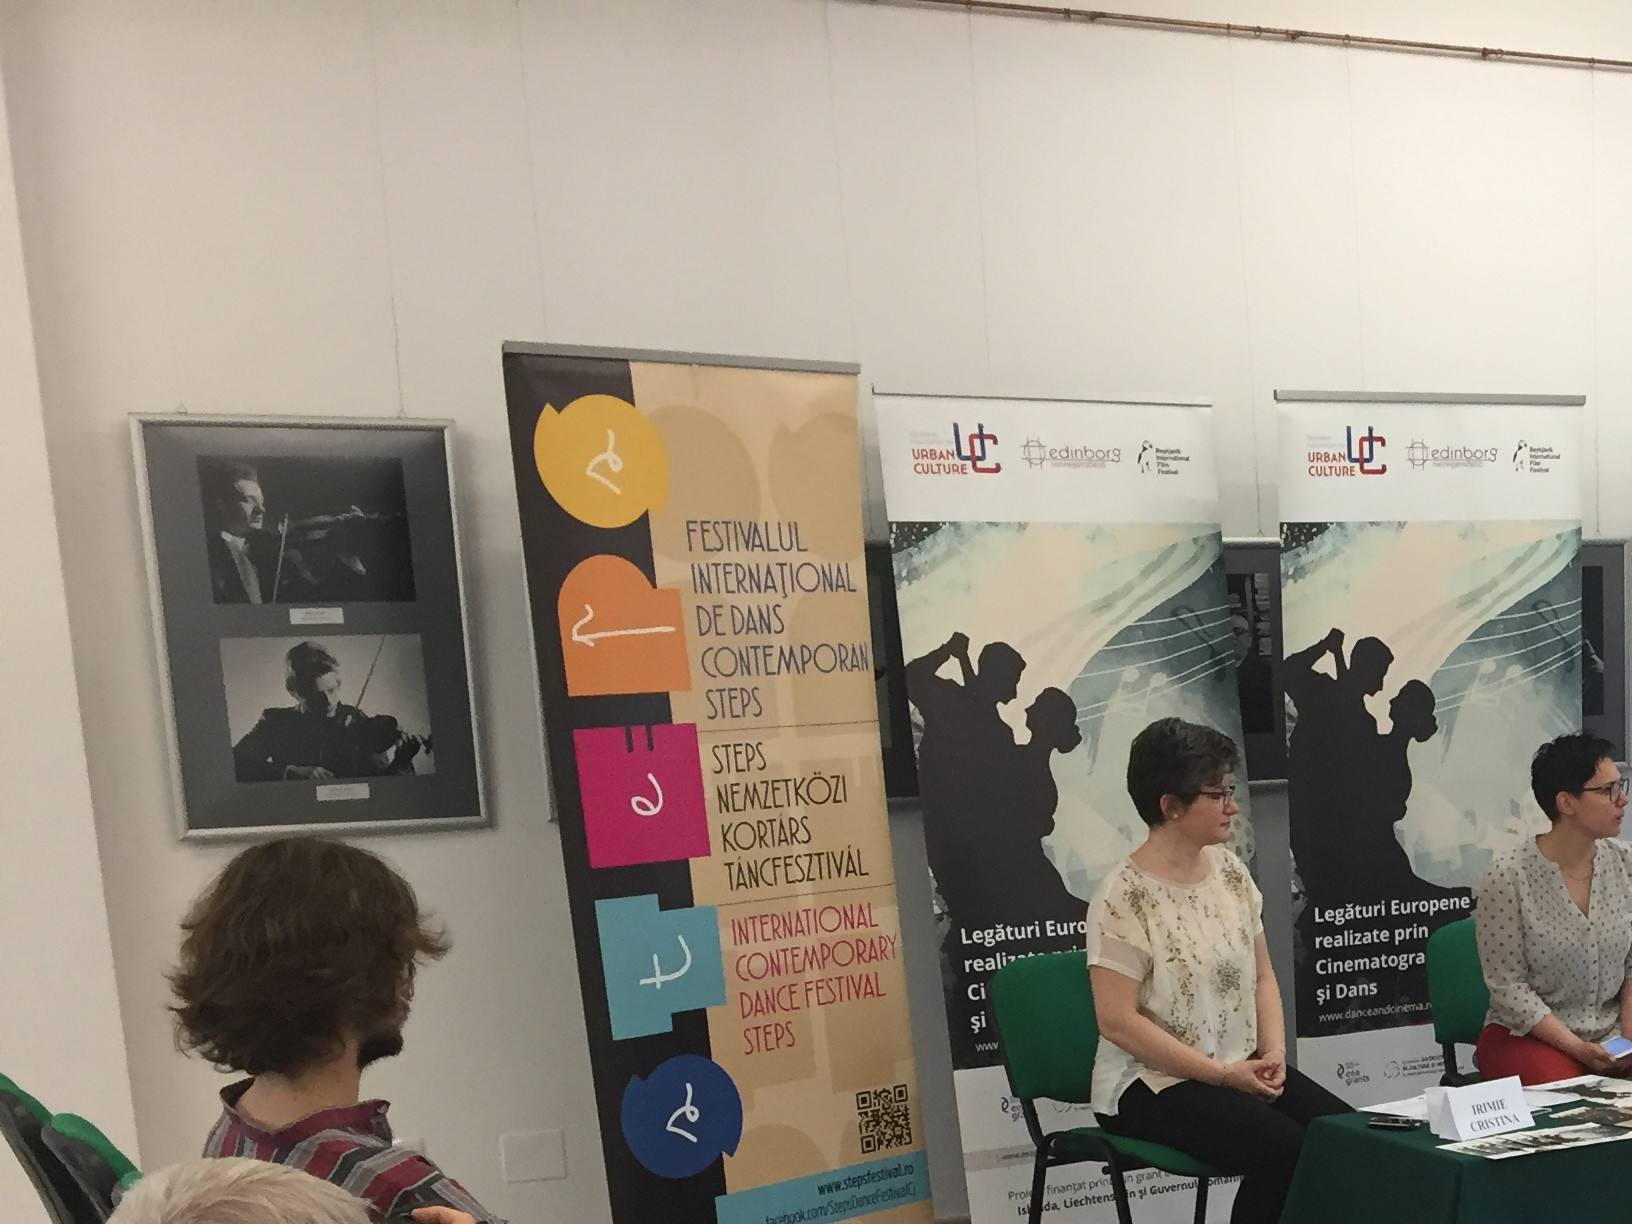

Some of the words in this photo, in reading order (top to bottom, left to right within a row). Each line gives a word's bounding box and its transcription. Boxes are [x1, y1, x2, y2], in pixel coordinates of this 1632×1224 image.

[912, 448, 955, 460] URBAN
[1049, 446, 1121, 463] edinborg
[1308, 452, 1346, 463] URBAN
[1431, 445, 1498, 463] edinborg
[914, 463, 968, 475] CULTURE
[1308, 466, 1355, 477] CULTURE
[686, 520, 808, 552] FESTIVALUL
[696, 604, 727, 636] DE
[731, 603, 785, 636] DANS
[701, 642, 869, 678] CONTEMPORAN
[706, 686, 763, 720] STEPS
[711, 742, 767, 774] STEPS
[716, 771, 848, 814] NEMZETKÖZI
[720, 813, 812, 853] KORTÁRS
[724, 845, 870, 891] TÁNCFESZTIVÁL
[731, 902, 879, 946] INTERNATIONAL
[1315, 900, 1386, 925] Legături
[1391, 896, 1471, 917] Europene
[960, 920, 1041, 948] Legături
[1045, 920, 1088, 937] Euro
[1315, 929, 1390, 949] realizate
[1395, 923, 1429, 945] prin
[736, 932, 897, 982] CONTEMPORARY
[1315, 951, 1426, 975] Cinematogra
[740, 983, 801, 1019] DANCE
[804, 971, 887, 1009] FESTIVAL
[1336, 982, 1378, 1000] Dans
[743, 1020, 796, 1056] STEPS
[1472, 1099, 1506, 1115] IRIMIE
[1470, 1114, 1520, 1132] CRISTINA
[817, 1164, 914, 1196] www.stepsfestival.ro
[1150, 1179, 1198, 1195] Guvernul
